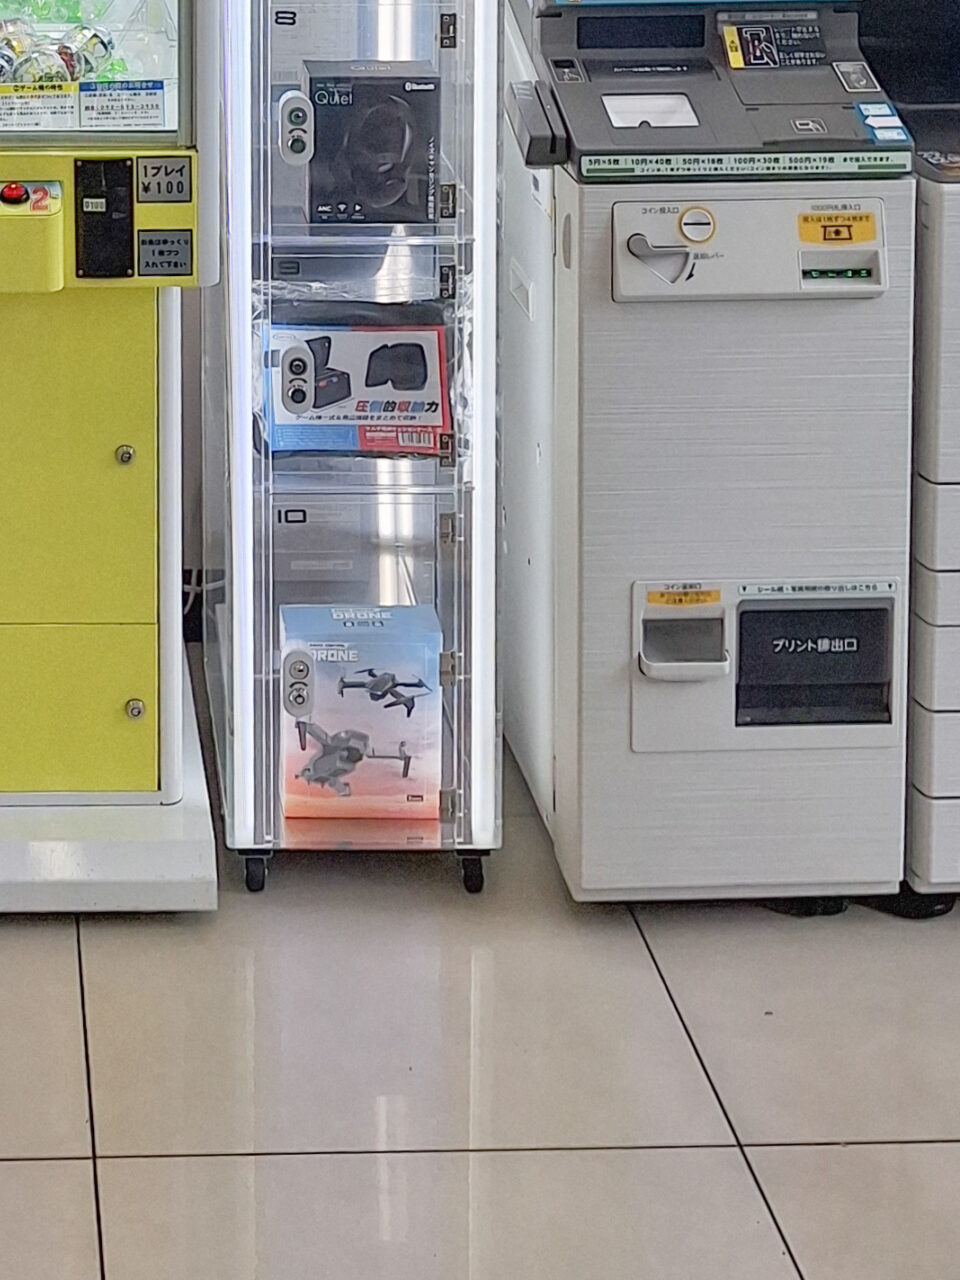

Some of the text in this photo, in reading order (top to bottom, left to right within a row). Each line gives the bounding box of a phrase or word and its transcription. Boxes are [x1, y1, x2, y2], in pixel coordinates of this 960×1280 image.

[274, 10, 297, 26] 8
[143, 164, 186, 178] 1プレイ
[141, 180, 184, 195] ¥100
[278, 508, 307, 524] 10
[773, 639, 858, 653] プリント排出口
